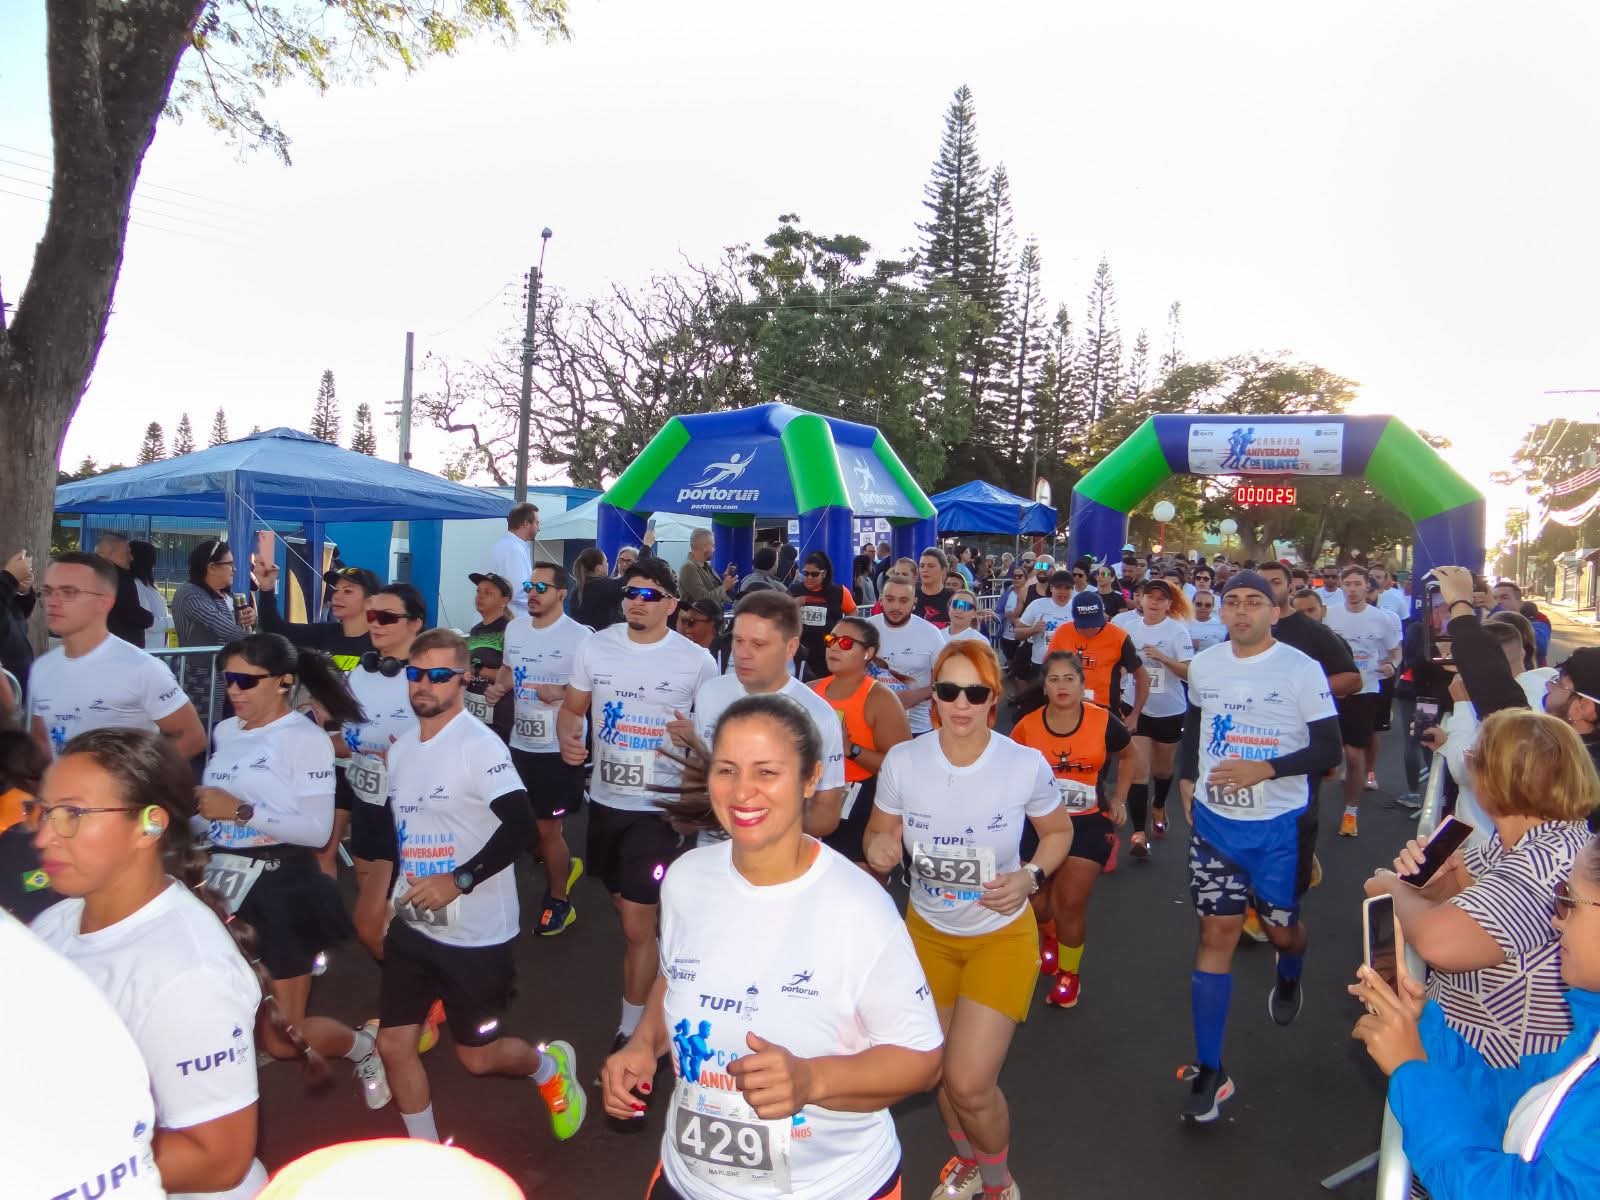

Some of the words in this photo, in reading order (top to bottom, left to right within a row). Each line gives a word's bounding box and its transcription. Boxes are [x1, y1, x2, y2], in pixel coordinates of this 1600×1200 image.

[677, 486, 760, 503] portorun
[1237, 487, 1294, 503] 000025
[616, 690, 638, 699] TUPI
[1224, 703, 1246, 711] TUPI
[517, 720, 544, 736] 203
[602, 763, 641, 786] 125
[933, 836, 964, 846] TUPI
[919, 857, 977, 884] 352
[781, 985, 819, 997] portorun
[699, 994, 743, 1013] TUPI
[176, 1047, 235, 1076] TUPI
[681, 1114, 763, 1167] 429
